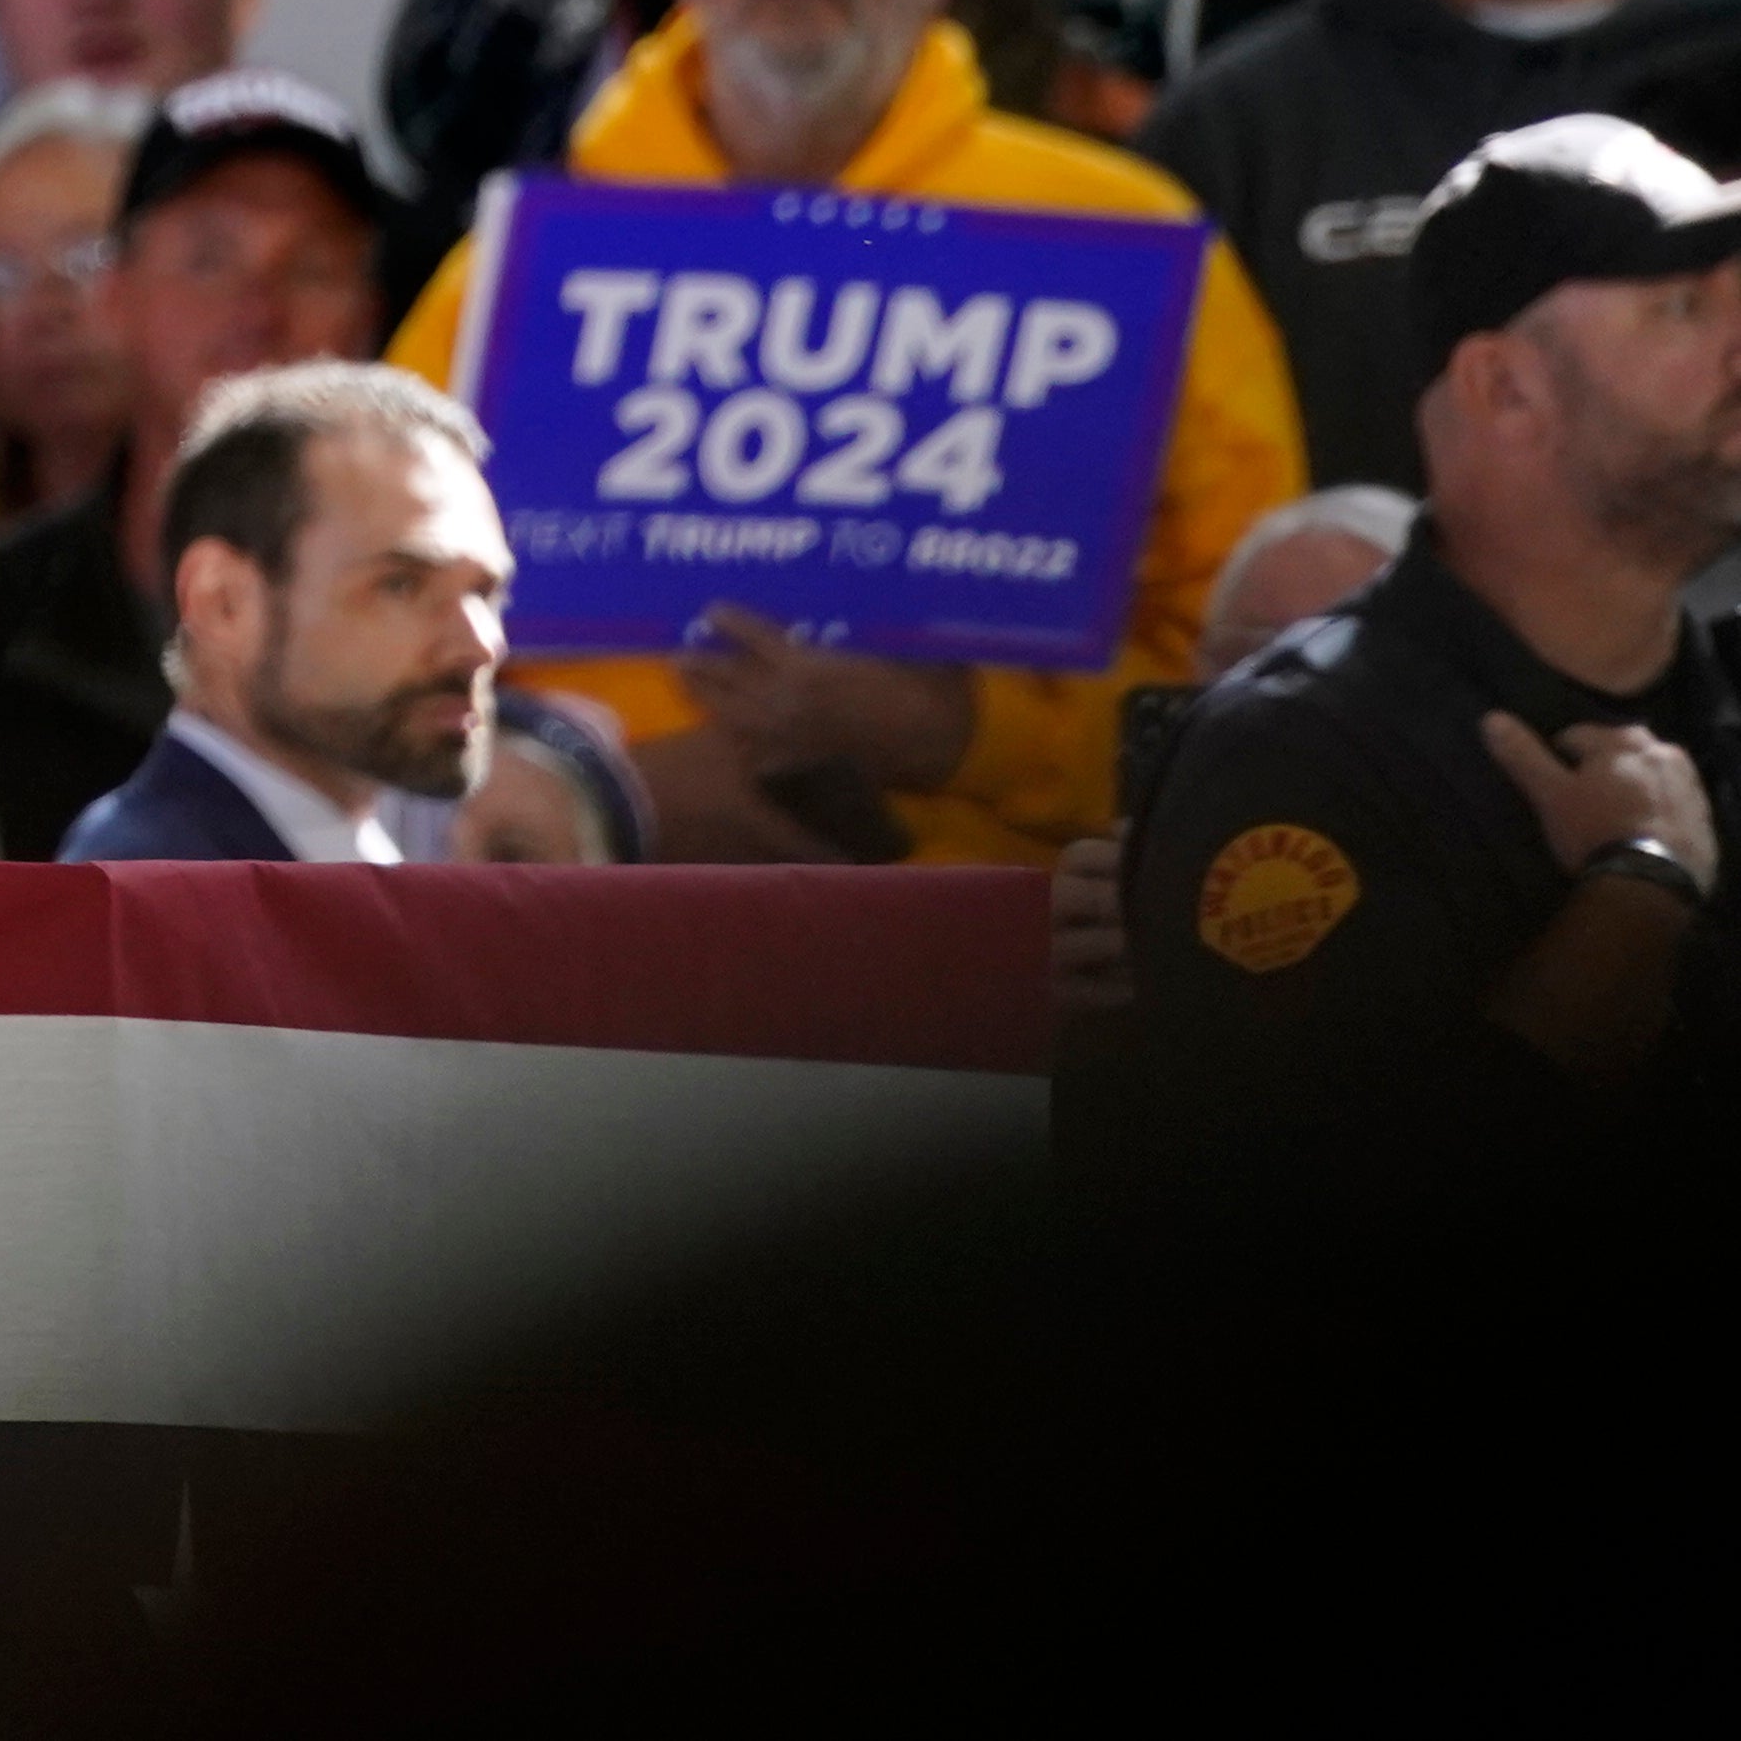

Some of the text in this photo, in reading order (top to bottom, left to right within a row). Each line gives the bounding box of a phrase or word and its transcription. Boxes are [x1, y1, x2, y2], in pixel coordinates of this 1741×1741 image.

[558, 267, 1120, 409] TRUMP
[596, 385, 1004, 515] 2024
[502, 507, 630, 563] TEXT
[641, 511, 821, 563] TRUMP
[828, 517, 906, 569] TO
